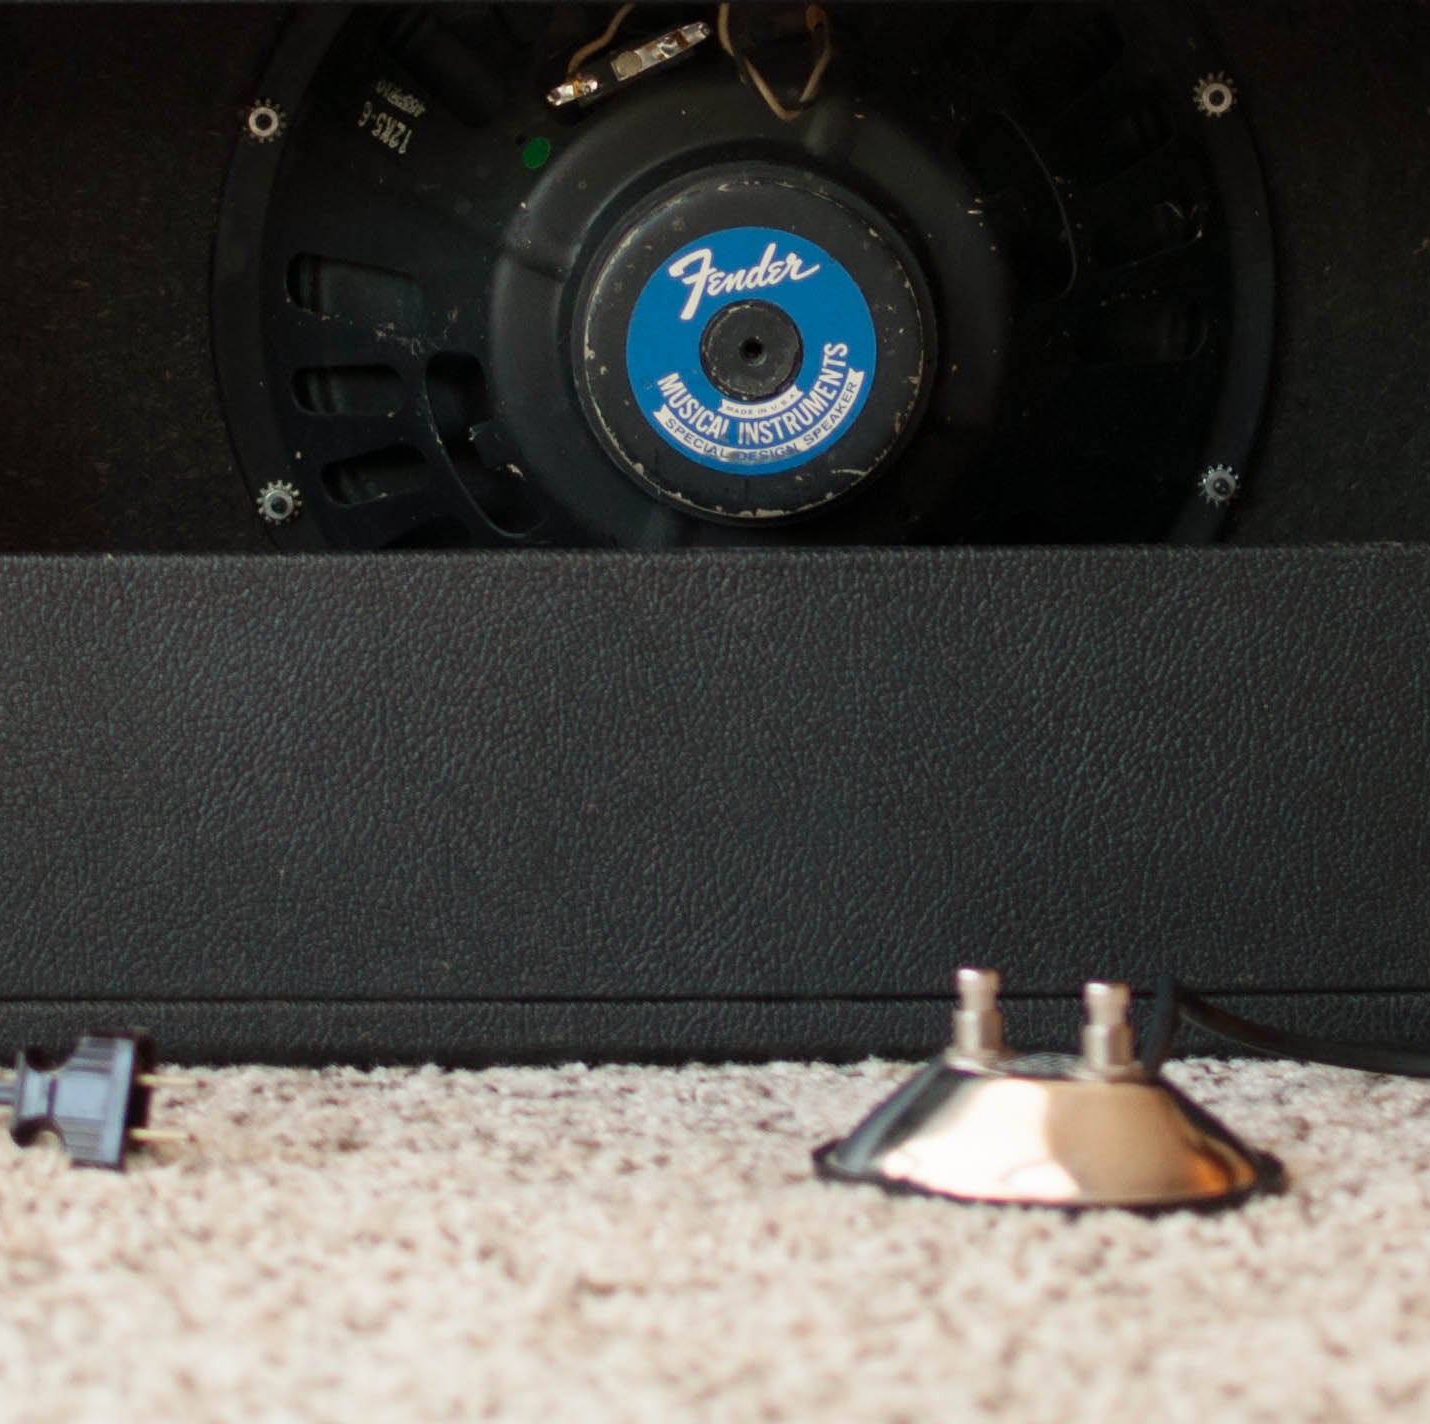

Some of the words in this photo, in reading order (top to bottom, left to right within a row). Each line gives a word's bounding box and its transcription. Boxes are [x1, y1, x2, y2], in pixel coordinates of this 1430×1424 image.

[668, 241, 821, 320] Fender
[657, 372, 730, 442] MUSICAL
[738, 342, 849, 445] INSTRUMENTS
[665, 418, 732, 459] SPECIAL
[737, 442, 799, 461] DESIGN
[802, 381, 859, 447] SPEAKER
[725, 405, 753, 415] MADE
[757, 407, 768, 415] IN
